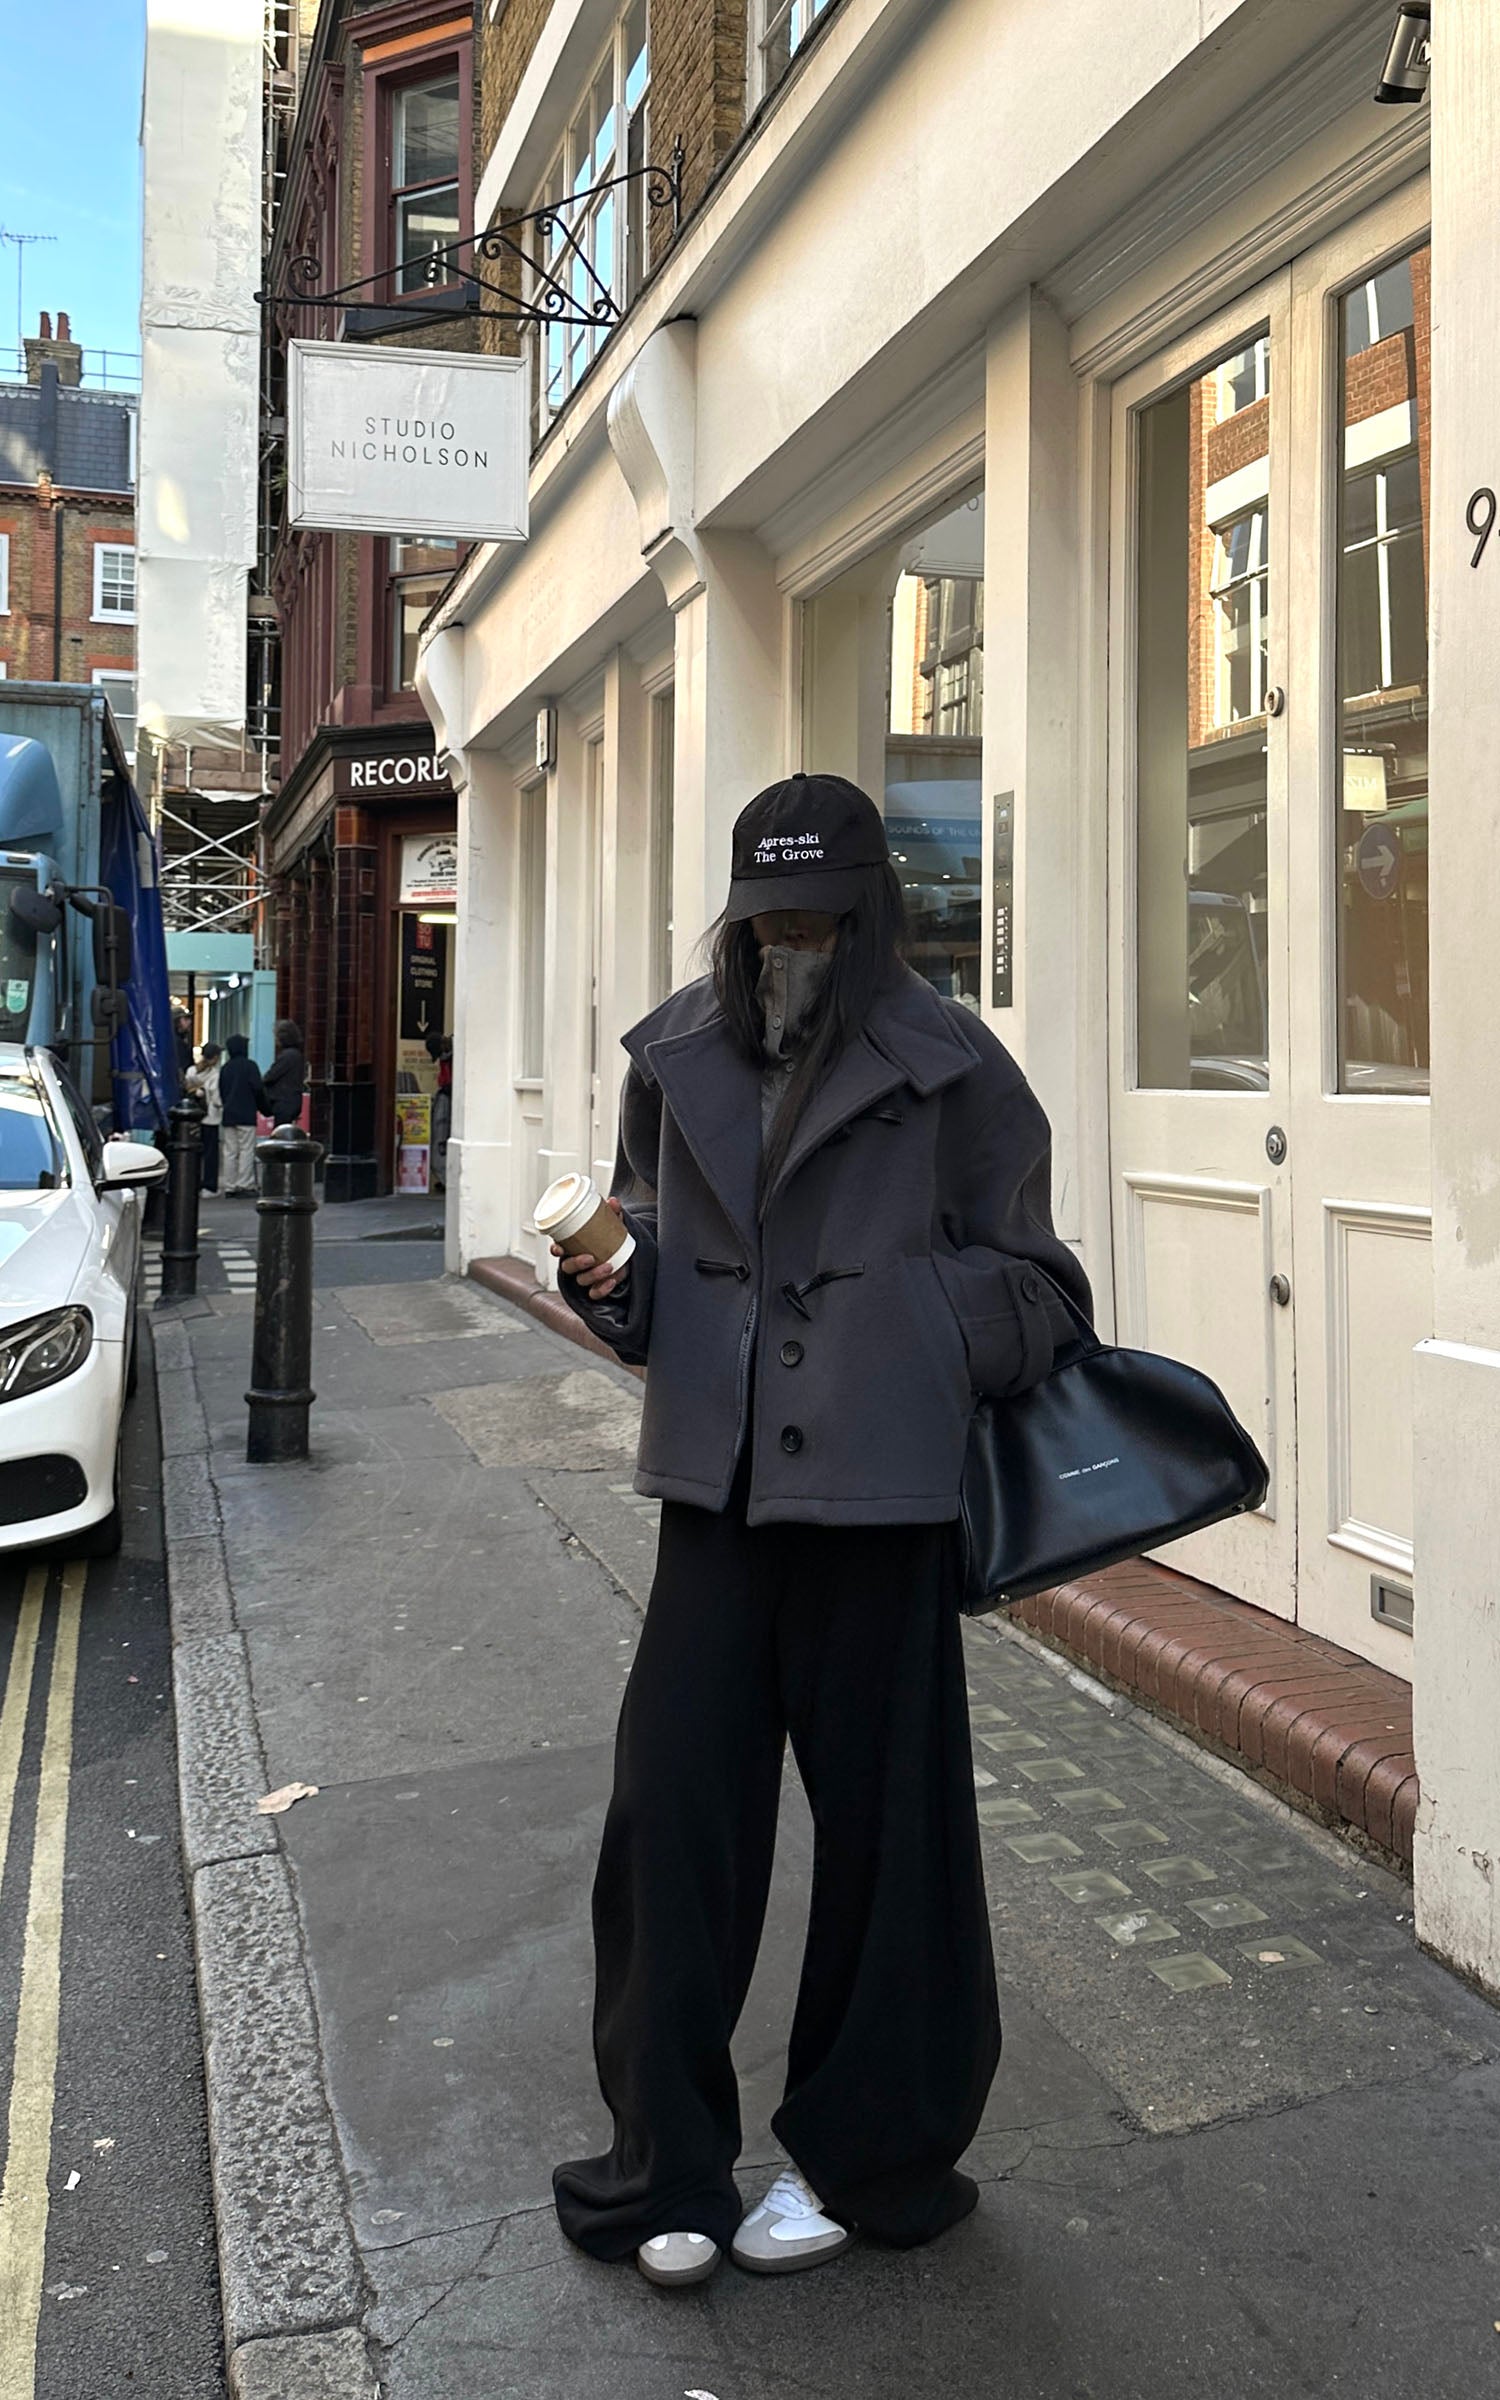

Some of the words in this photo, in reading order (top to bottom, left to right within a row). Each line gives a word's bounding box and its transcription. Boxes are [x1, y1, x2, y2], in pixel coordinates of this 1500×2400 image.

[365, 416, 455, 440] STUDIO
[331, 440, 488, 468] NICHOLSON
[1466, 487, 1500, 569] 9
[758, 833, 820, 850] Apres-ski
[754, 851, 777, 863] The
[782, 849, 824, 861] Grove
